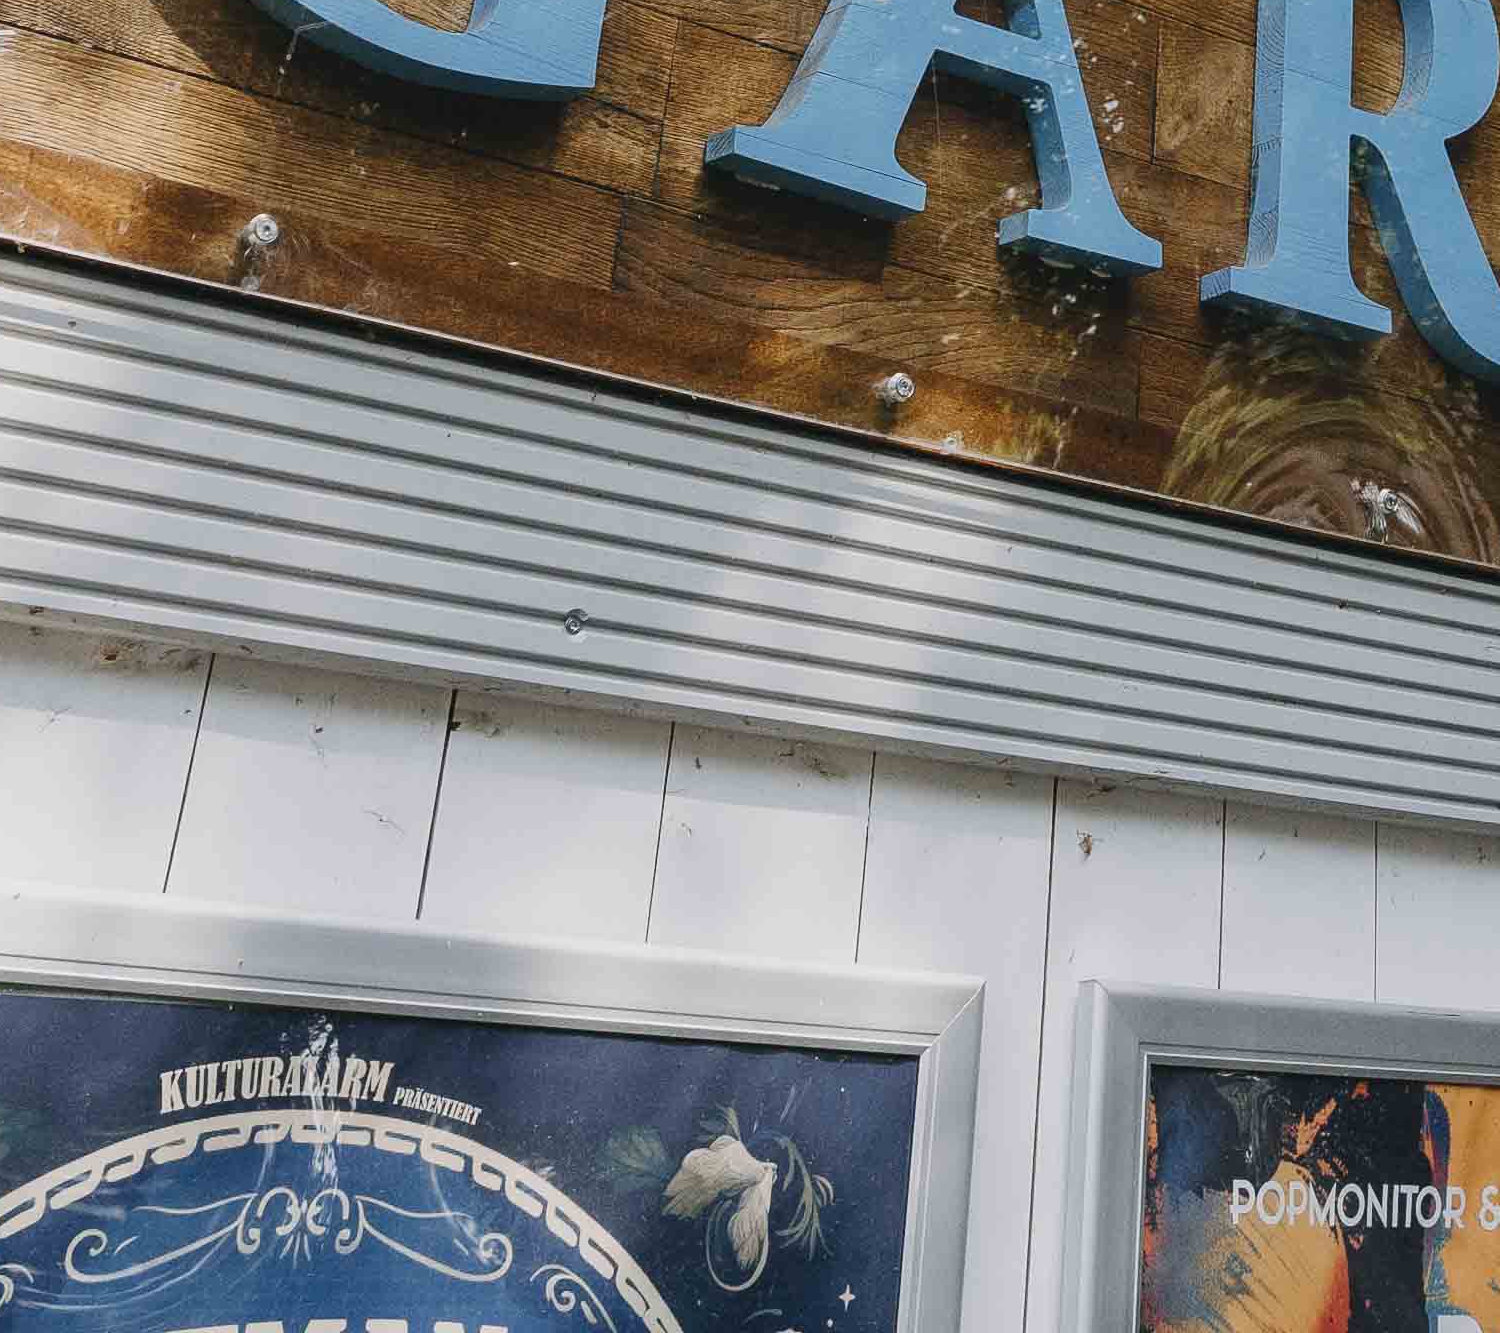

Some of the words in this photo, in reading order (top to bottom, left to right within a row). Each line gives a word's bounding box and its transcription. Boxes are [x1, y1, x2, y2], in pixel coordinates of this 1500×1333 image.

[159, 1056, 396, 1114] KULTURALARM
[395, 1086, 483, 1126] PRÄSENTIERT
[1229, 1179, 1466, 1229] POPMONITOR
